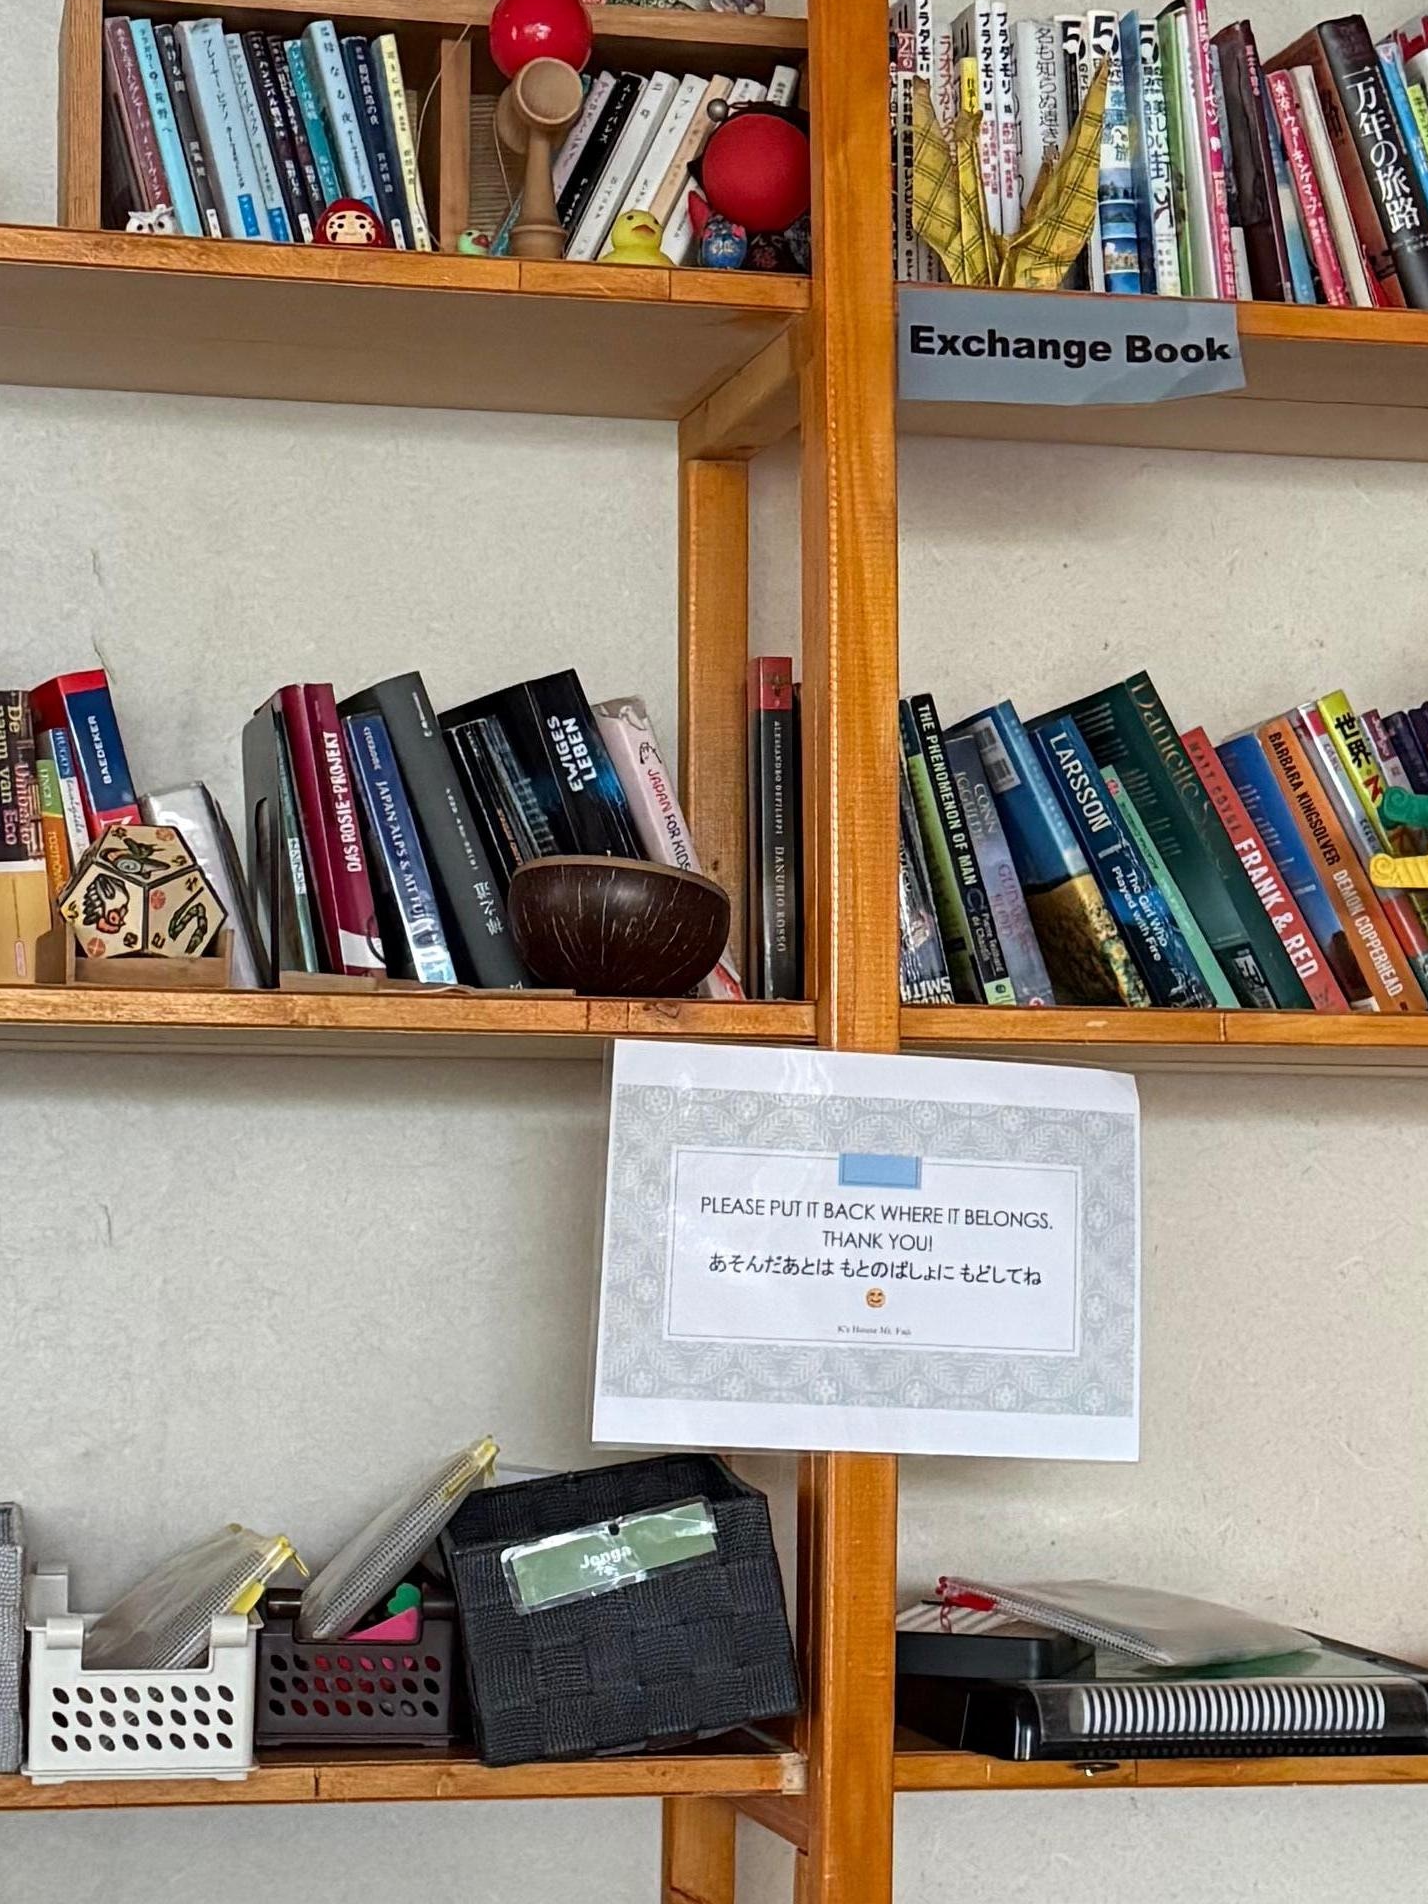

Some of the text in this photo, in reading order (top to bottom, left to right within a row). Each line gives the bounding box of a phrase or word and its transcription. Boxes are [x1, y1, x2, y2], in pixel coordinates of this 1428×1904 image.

[978, 12, 994, 95] ブラタモリ
[996, 12, 1013, 95] ブラタモリ
[1341, 67, 1422, 235] 一万年の旅路
[909, 325, 1233, 369] Exchange Book
[6, 703, 24, 732] De
[86, 713, 112, 785] BAEDEKER
[546, 714, 583, 793] EWIGES
[563, 716, 597, 783] LEBEN
[1333, 711, 1374, 770] 世界
[11, 762, 40, 846] Umberto
[323, 730, 363, 874] DAS ROSIE-PROJEKT
[374, 778, 398, 823] JAPAN
[646, 768, 671, 814] JAPAN
[661, 802, 684, 841] FOR
[917, 703, 976, 887] THE PHENOMENON OF MAN
[1049, 730, 1112, 834] LARSSON
[1, 808, 19, 845] Eco
[387, 822, 408, 857] ALPS
[398, 858, 411, 870] &
[402, 872, 418, 894] MT
[774, 845, 787, 954] DANUBIO ROSSO
[1268, 730, 1405, 998] BARBARA KINGSOLVER DEMON COPPERHEAD
[1111, 865, 1163, 963] Played with Fire
[1125, 867, 1169, 948] The Girl Who
[1232, 836, 1283, 914] FRANK
[1272, 910, 1294, 934] &
[1283, 934, 1318, 981] RED
[700, 1196, 1054, 1230] PLEASE PUT IT BACK WHERE IT BELONGS.
[822, 1230, 934, 1253] THANK YOU!
[708, 1252, 1042, 1286] あそんだあとは もとのばしょに もどしてね
